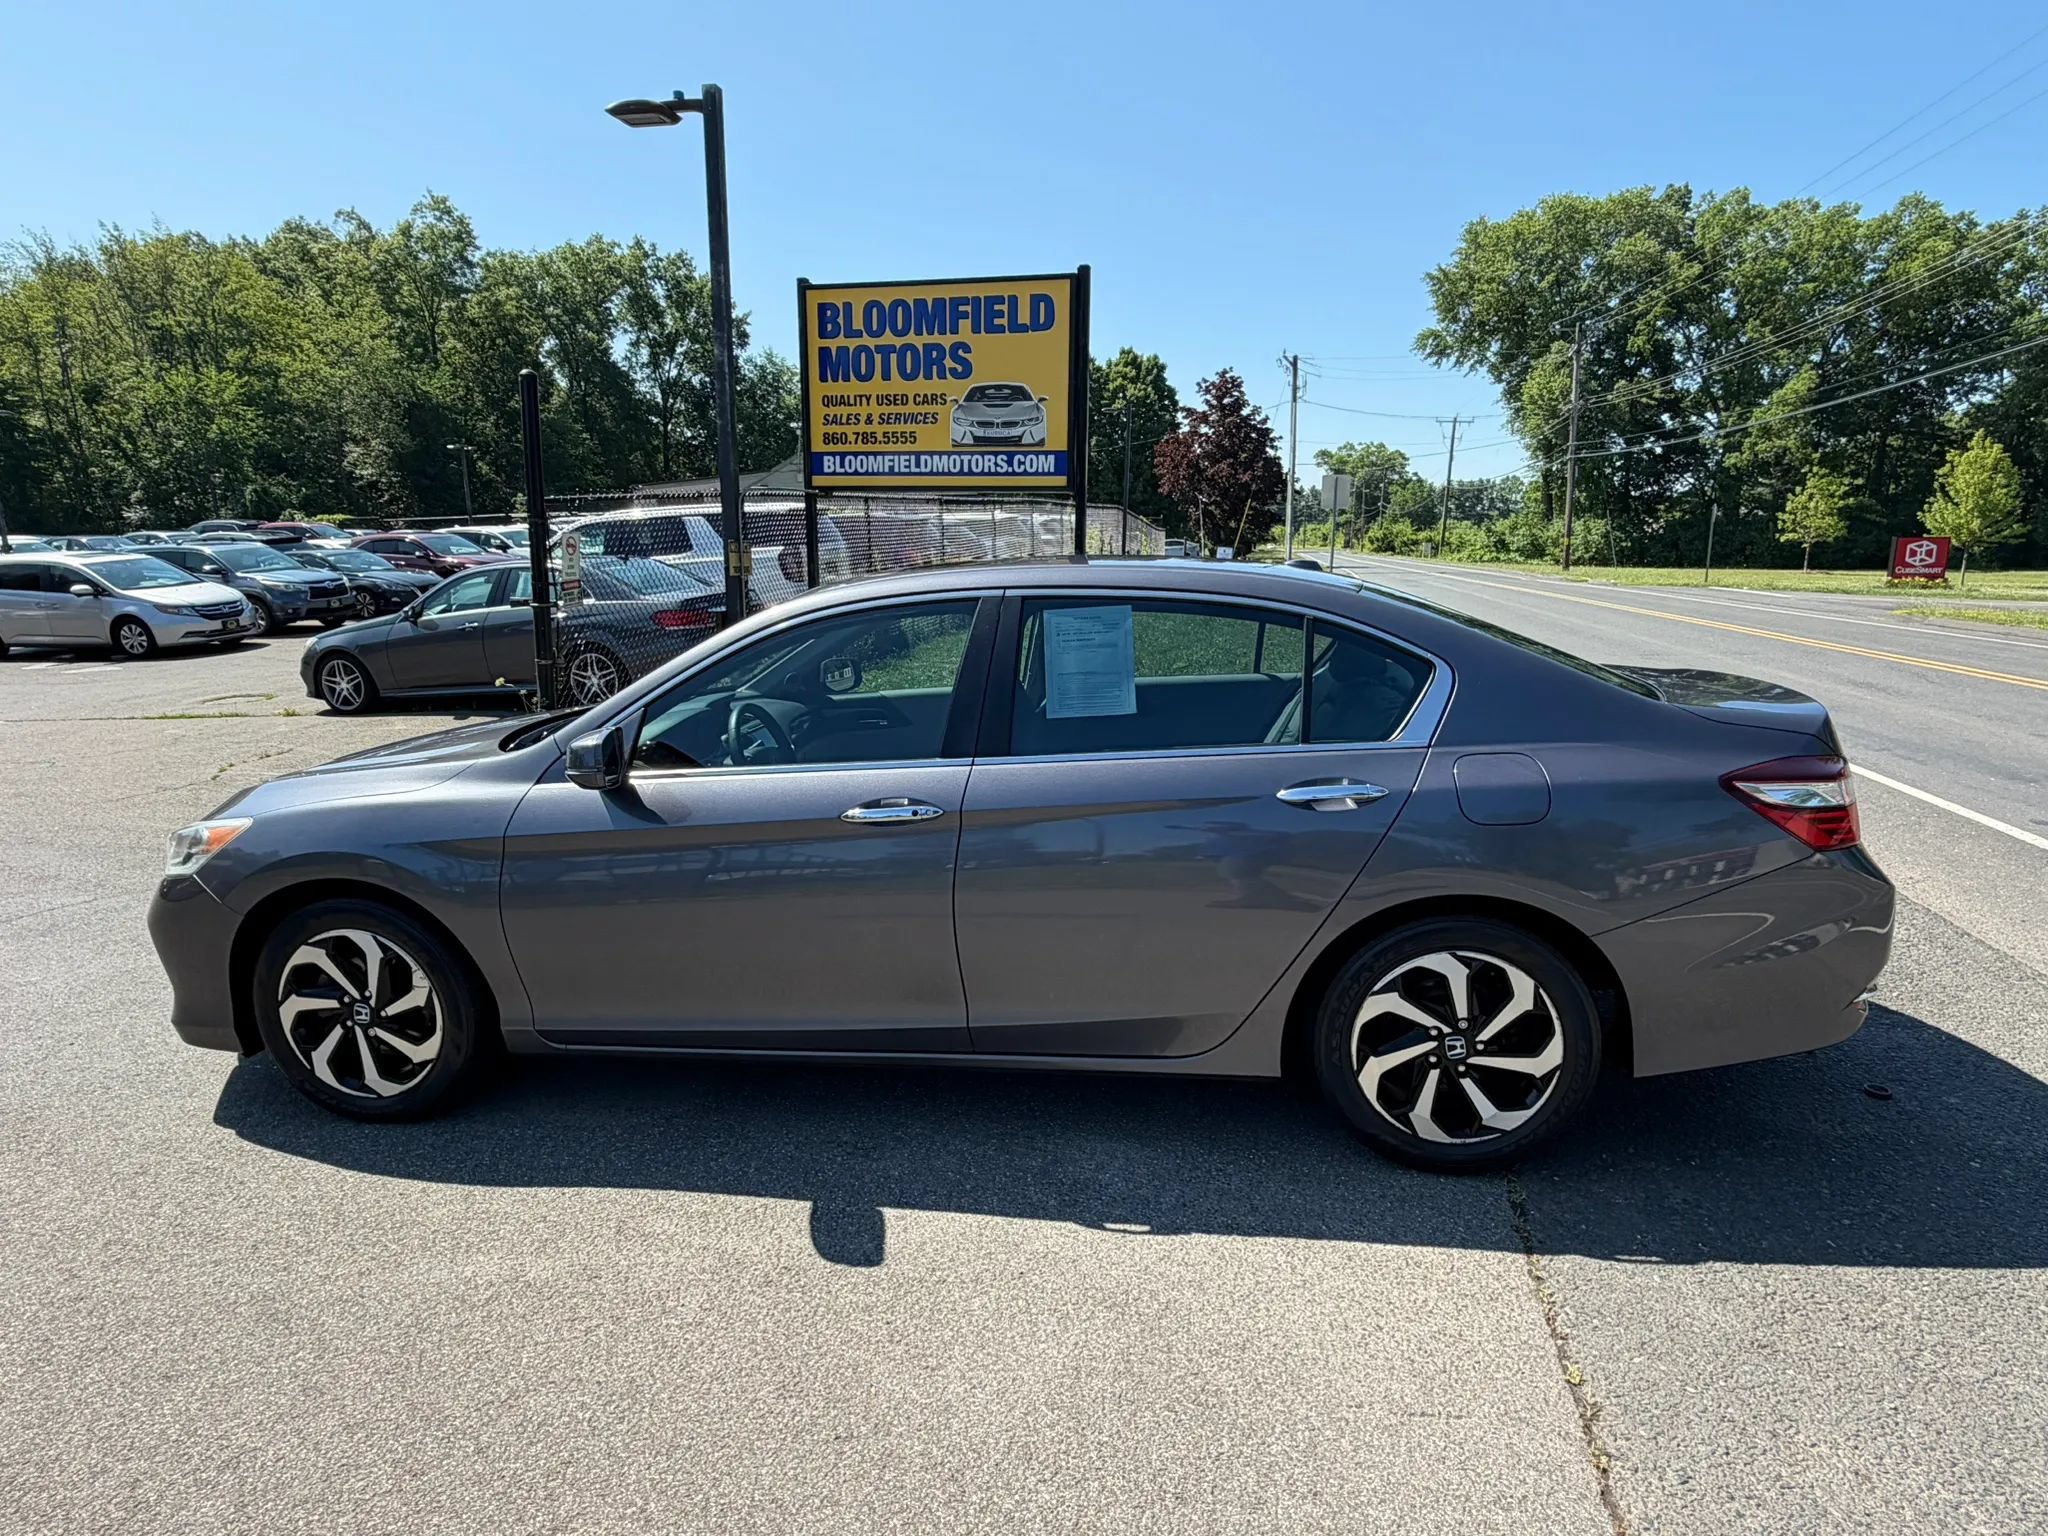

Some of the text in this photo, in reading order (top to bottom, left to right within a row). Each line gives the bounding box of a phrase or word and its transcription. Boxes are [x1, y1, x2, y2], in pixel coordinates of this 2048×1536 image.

[817, 293, 1055, 339] BLOOMFIELD
[818, 341, 972, 382] MOTORS
[822, 393, 947, 408] QUALITY USED CARS
[822, 412, 939, 426] SALES & SERVICES
[822, 431, 917, 445] 860.785.5555
[823, 454, 1055, 473] BLOOMFIELDMOTORS.COM
